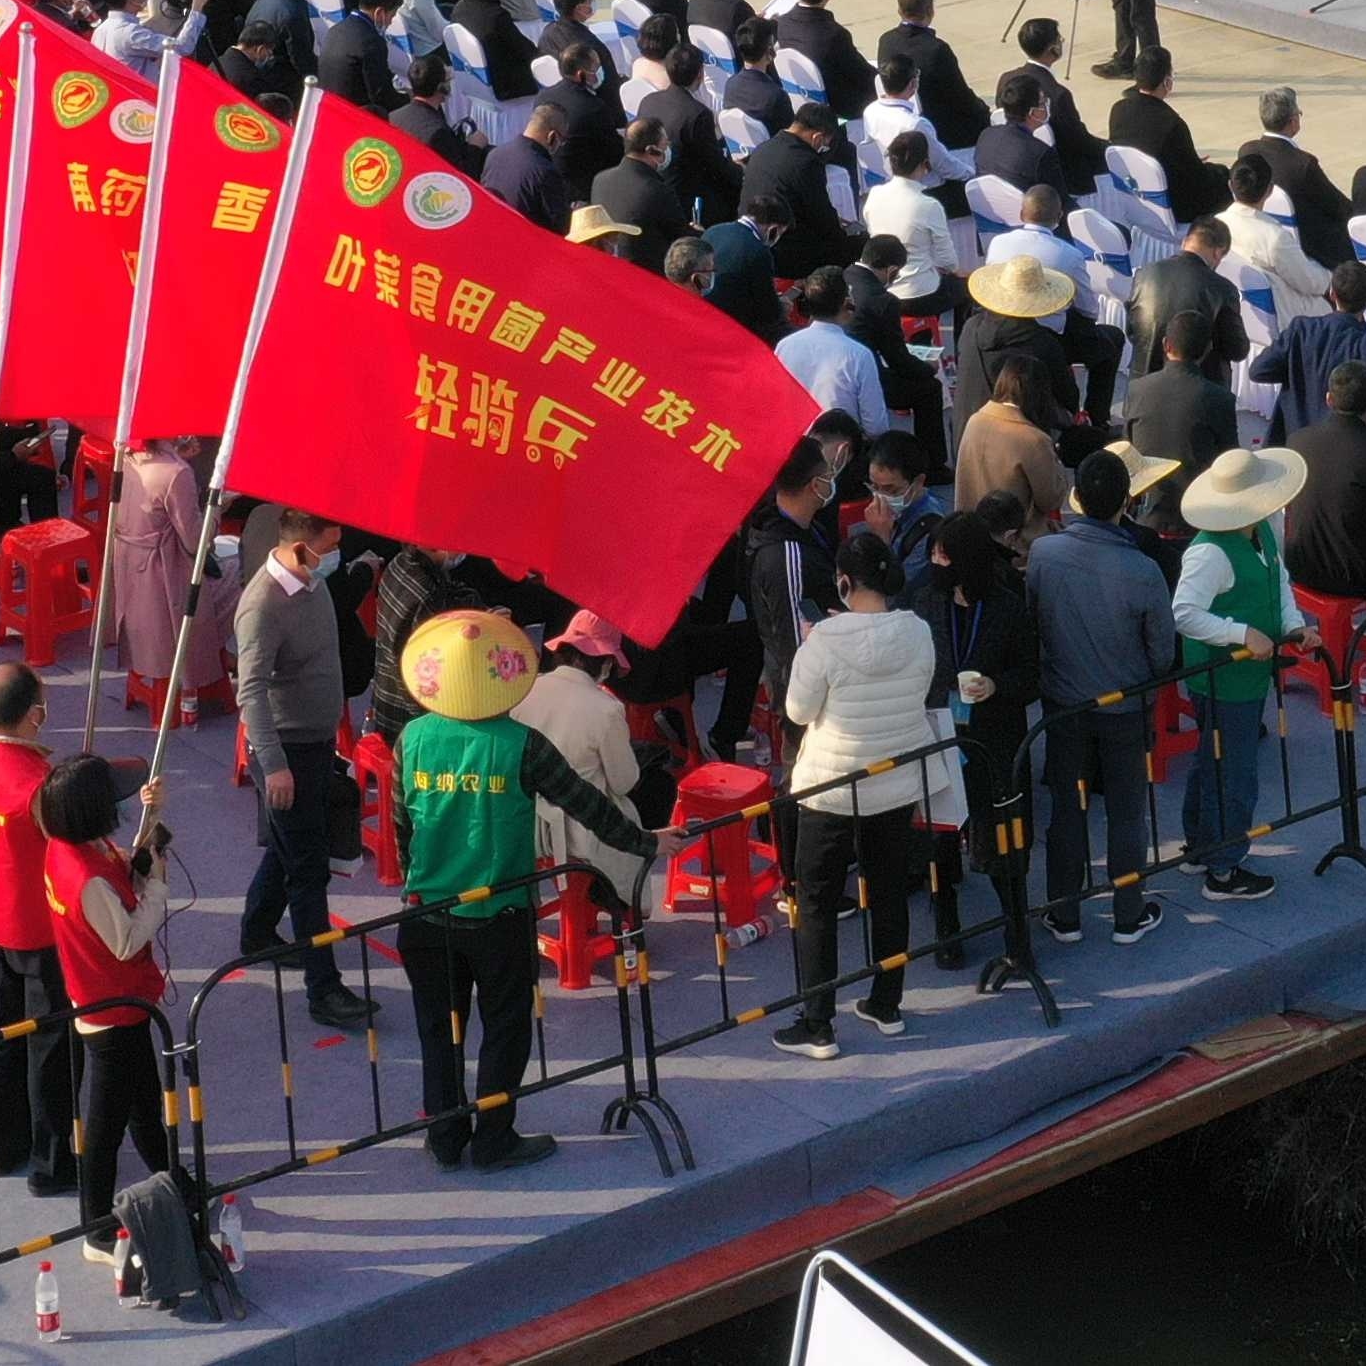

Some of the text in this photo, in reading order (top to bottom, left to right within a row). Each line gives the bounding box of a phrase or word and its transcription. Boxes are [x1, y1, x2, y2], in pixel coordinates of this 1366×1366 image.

[211, 180, 272, 234] 香
[323, 233, 743, 472] 叶菜食用菌产业技术
[409, 352, 597, 470] 轻骑兵
